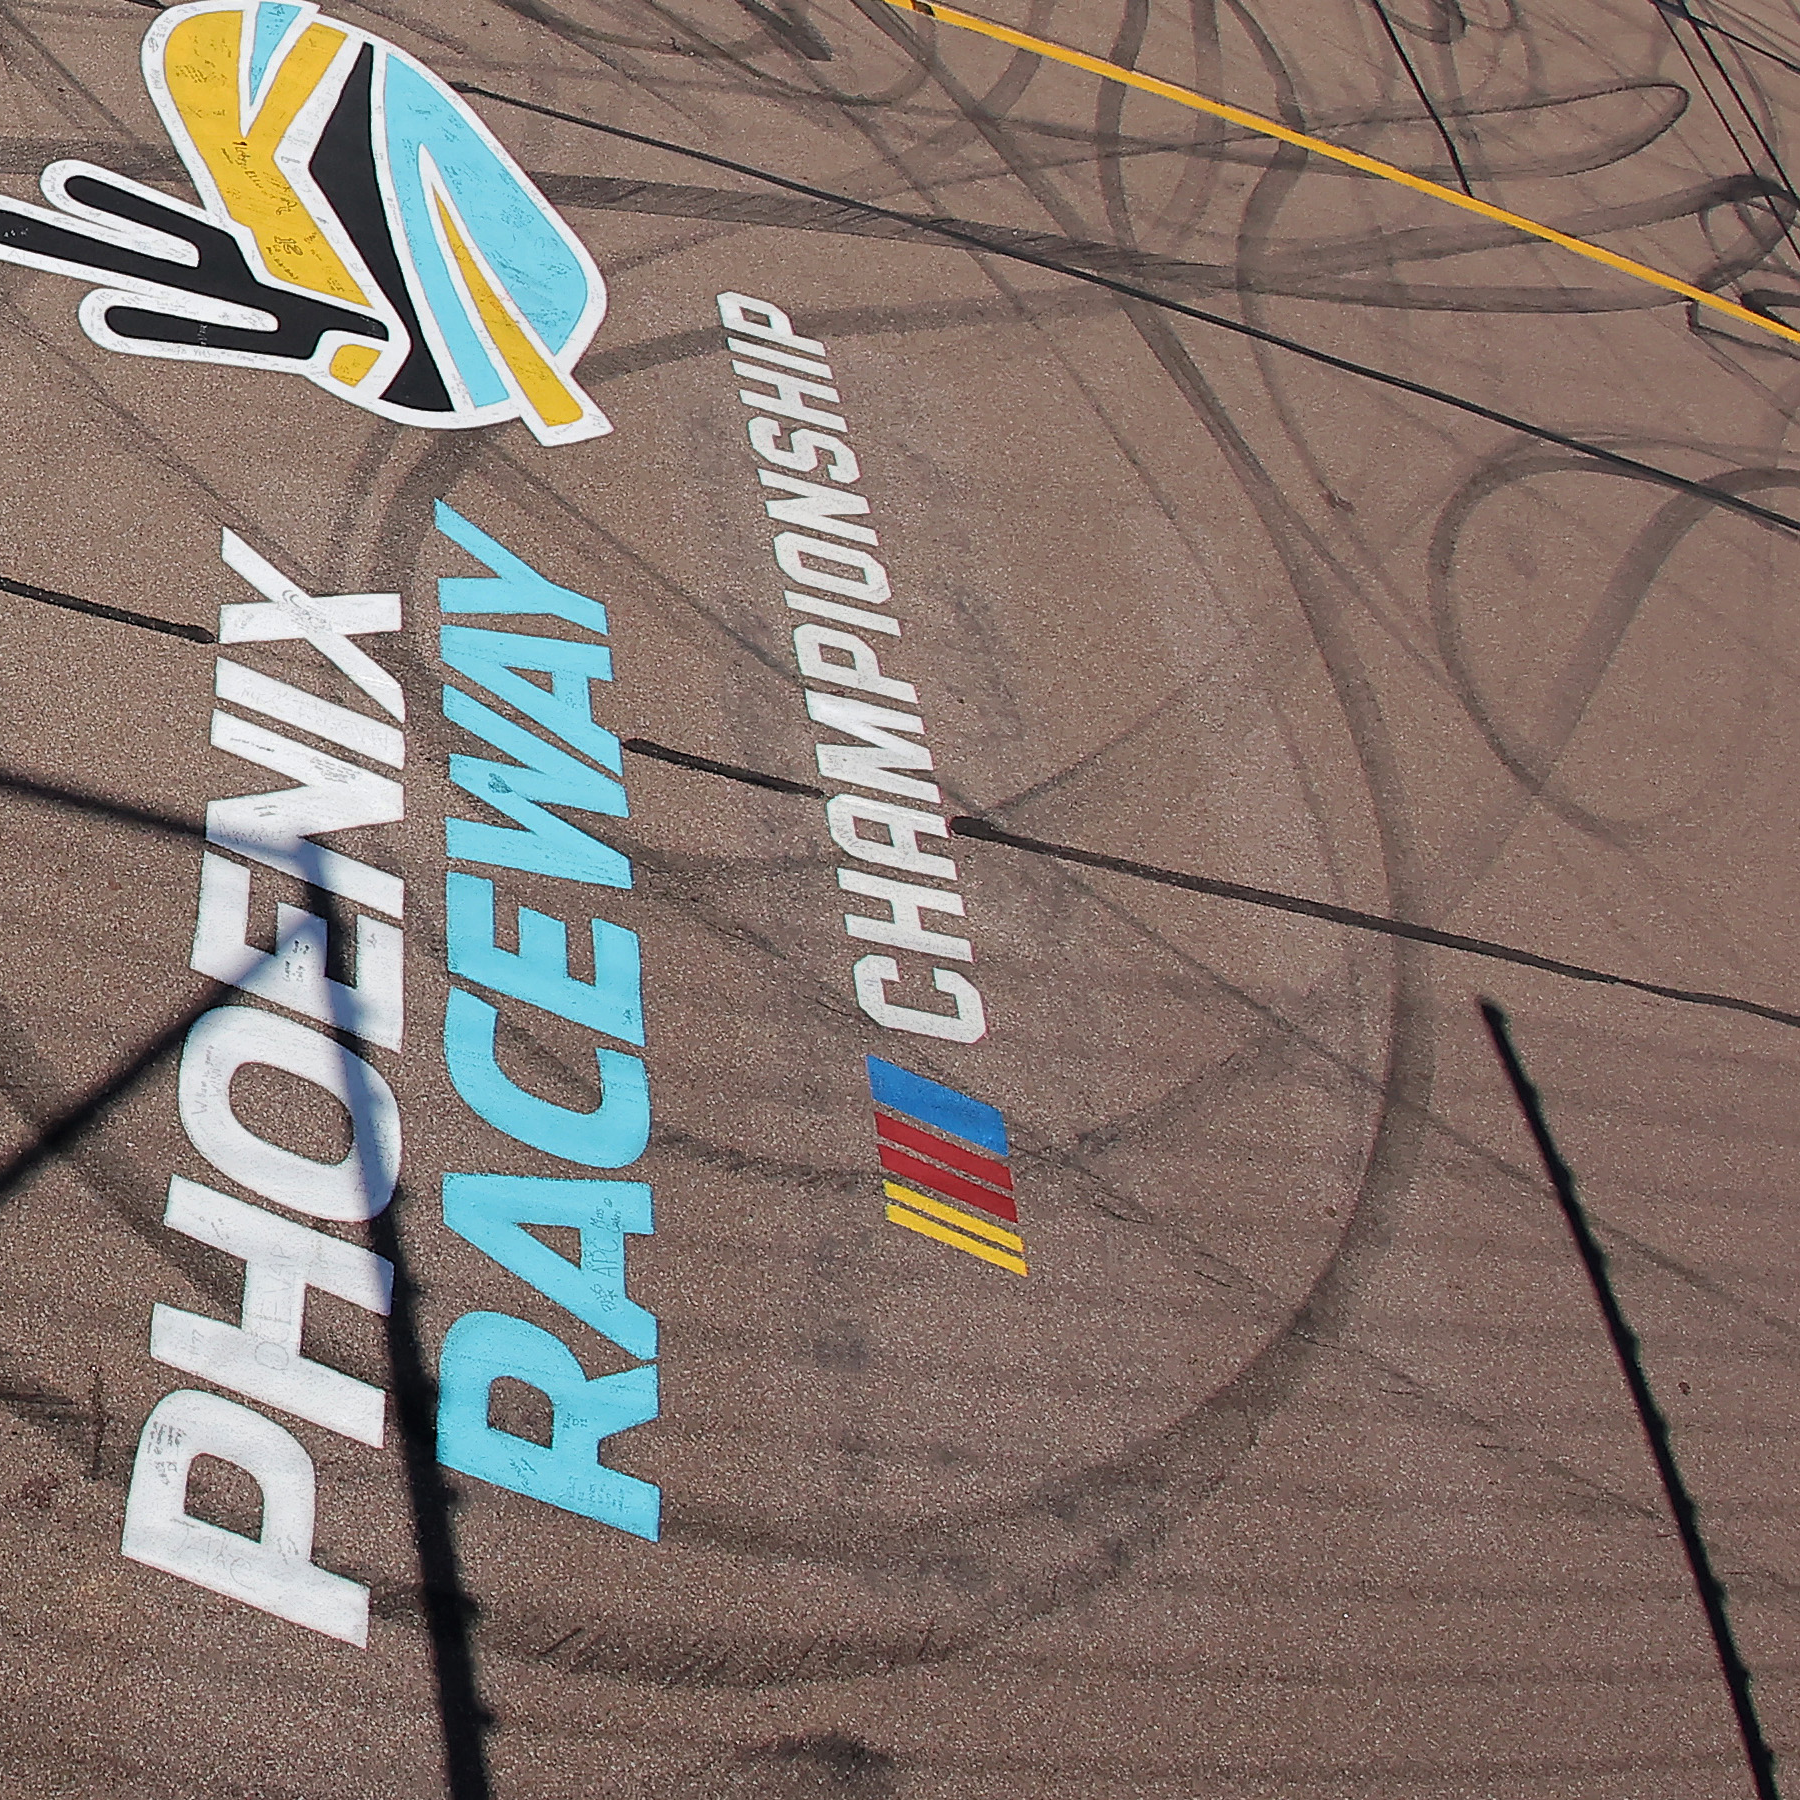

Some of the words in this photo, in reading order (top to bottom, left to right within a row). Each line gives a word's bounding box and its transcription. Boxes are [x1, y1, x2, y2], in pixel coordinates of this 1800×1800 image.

[122, 527, 404, 1648] PHOENIX
[435, 499, 661, 1541] RACEWAY
[717, 291, 992, 1044] CHAMPIONSHIP
